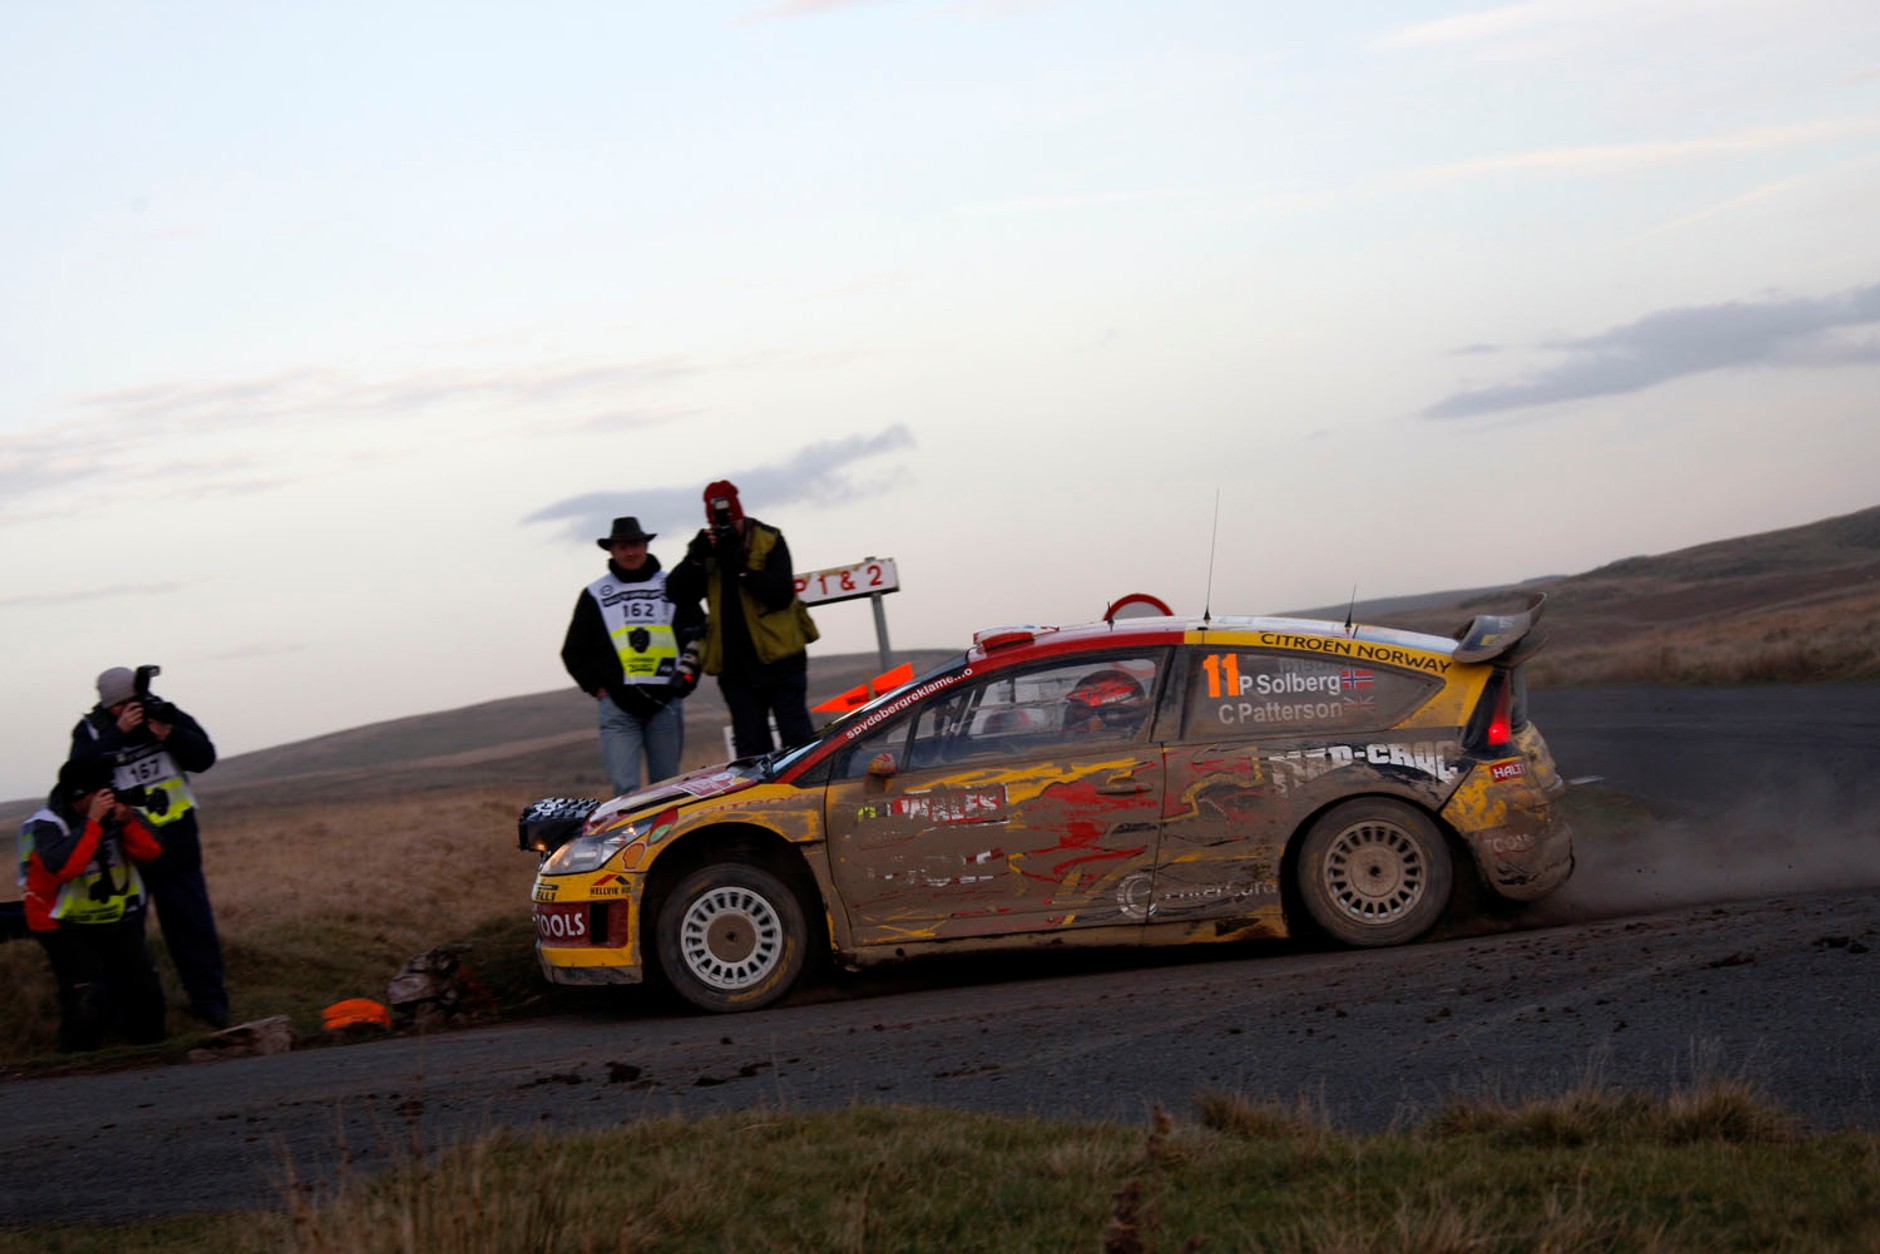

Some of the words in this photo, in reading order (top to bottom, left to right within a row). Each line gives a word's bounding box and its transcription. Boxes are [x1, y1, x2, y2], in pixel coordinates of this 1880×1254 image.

[817, 575, 828, 595] 1
[840, 570, 856, 591] &
[867, 565, 883, 587] 2
[622, 603, 654, 618] 162
[1357, 643, 1452, 674] NORWAY
[1202, 653, 1240, 698] 11
[1239, 675, 1253, 696] P
[1257, 673, 1341, 695] Solberg
[1218, 703, 1235, 725] C
[1238, 701, 1344, 724] Patterson
